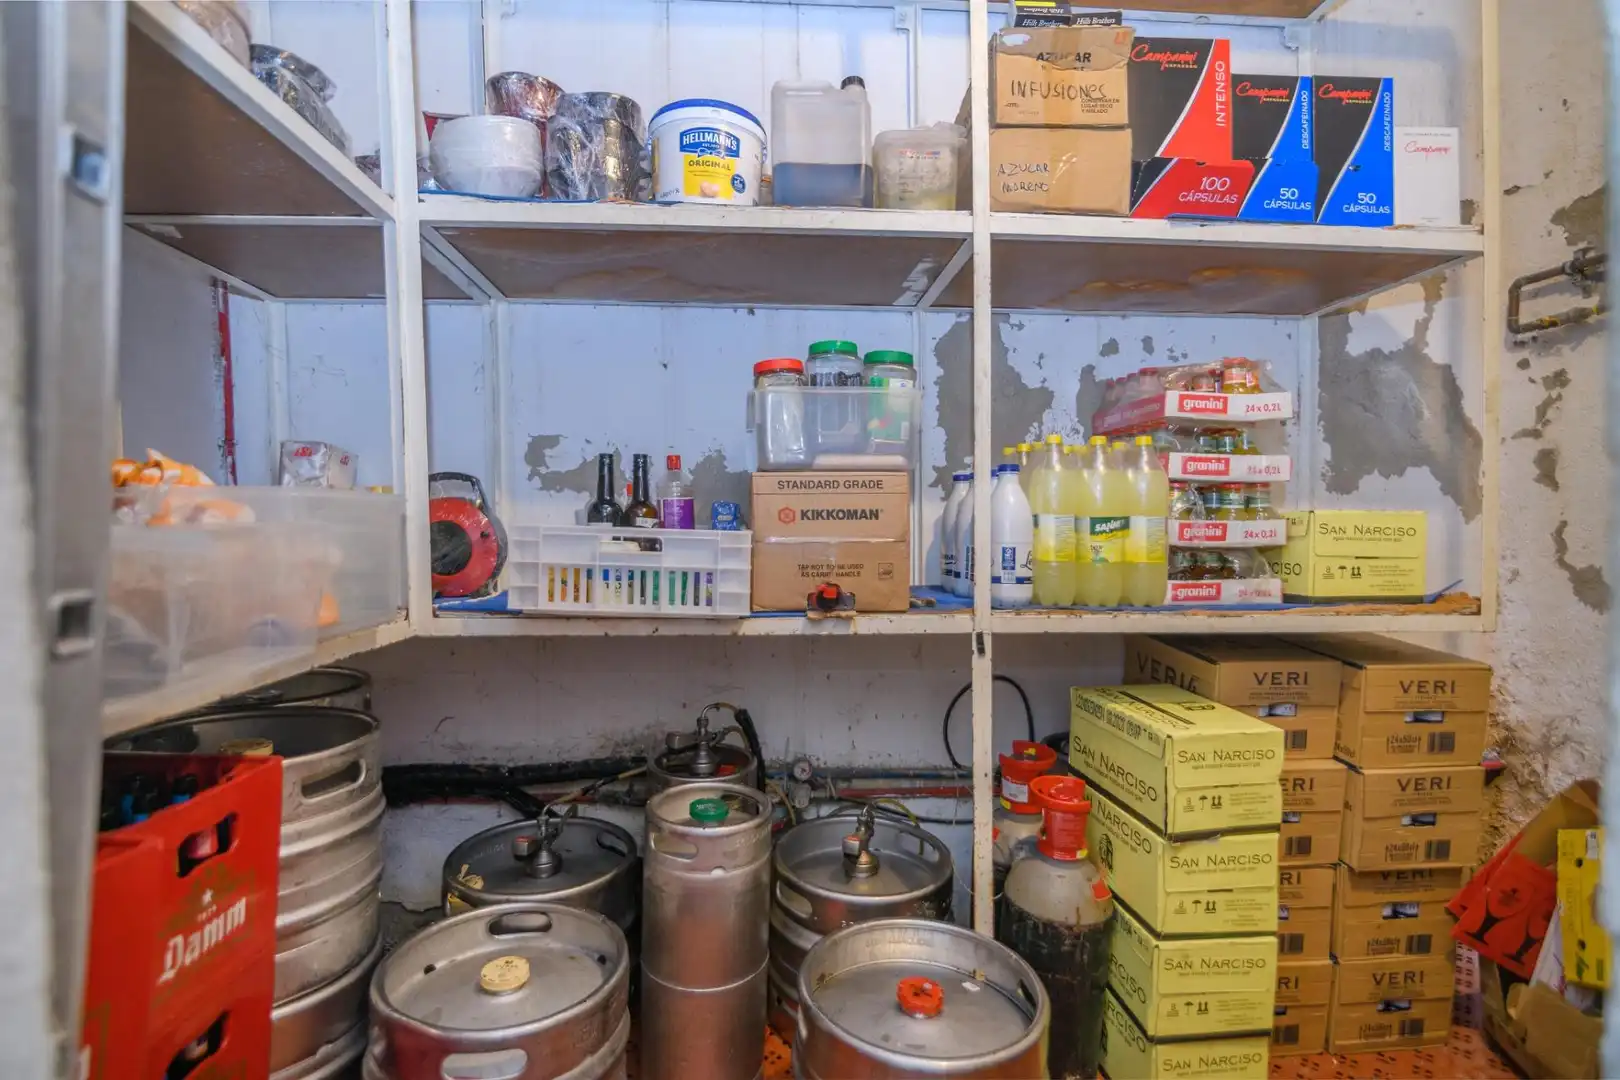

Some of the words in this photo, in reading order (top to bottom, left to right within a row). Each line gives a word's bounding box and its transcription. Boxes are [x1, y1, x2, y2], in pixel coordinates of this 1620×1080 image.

[1076, 17, 1091, 25] Hills
[1215, 60, 1225, 127] INTENSO
[1301, 90, 1309, 149] DESCAFEINADO
[1383, 92, 1391, 151] DESCAFEINADO
[683, 131, 738, 150] HELLMANN'S
[688, 160, 732, 171] ORIGINAL
[1200, 177, 1230, 191] 100
[1178, 191, 1239, 204] CÁPSULAS
[1279, 188, 1298, 199] 50
[1357, 192, 1376, 204] 50
[1263, 199, 1312, 210] CÁPSULAS
[1342, 203, 1390, 214] CÁPSULAS
[1183, 398, 1224, 411] granini
[1187, 460, 1225, 472] granini
[777, 480, 840, 490] STANDARD
[843, 480, 884, 490] GRADE
[800, 508, 880, 521] KIKKOMAN
[1183, 526, 1223, 538] granini
[1353, 524, 1417, 537] NARCISO
[1268, 560, 1302, 576] CISO
[1176, 585, 1217, 599] granini
[1253, 671, 1308, 686] VERI
[1399, 680, 1456, 694] VERI
[1178, 750, 1206, 763] SAN
[1213, 749, 1276, 761] NARCISO
[1099, 752, 1158, 802] NARCISO
[1397, 776, 1451, 792] VERI
[1279, 777, 1315, 792] ERI
[1097, 799, 1152, 854] NARCISO
[1169, 855, 1200, 869] SAN
[1206, 853, 1272, 867] NARCISO
[1280, 871, 1301, 885] RI
[156, 897, 247, 986] Damm
[1163, 958, 1194, 971] SAN
[1200, 957, 1267, 970] NARCISO
[1109, 953, 1146, 1004] RCISO
[1278, 976, 1299, 990] RI
[1372, 970, 1424, 986] VERI
[1107, 1000, 1146, 1053] RCISO
[1162, 1058, 1192, 1071] SAN
[1199, 1052, 1263, 1068] NARCISO
